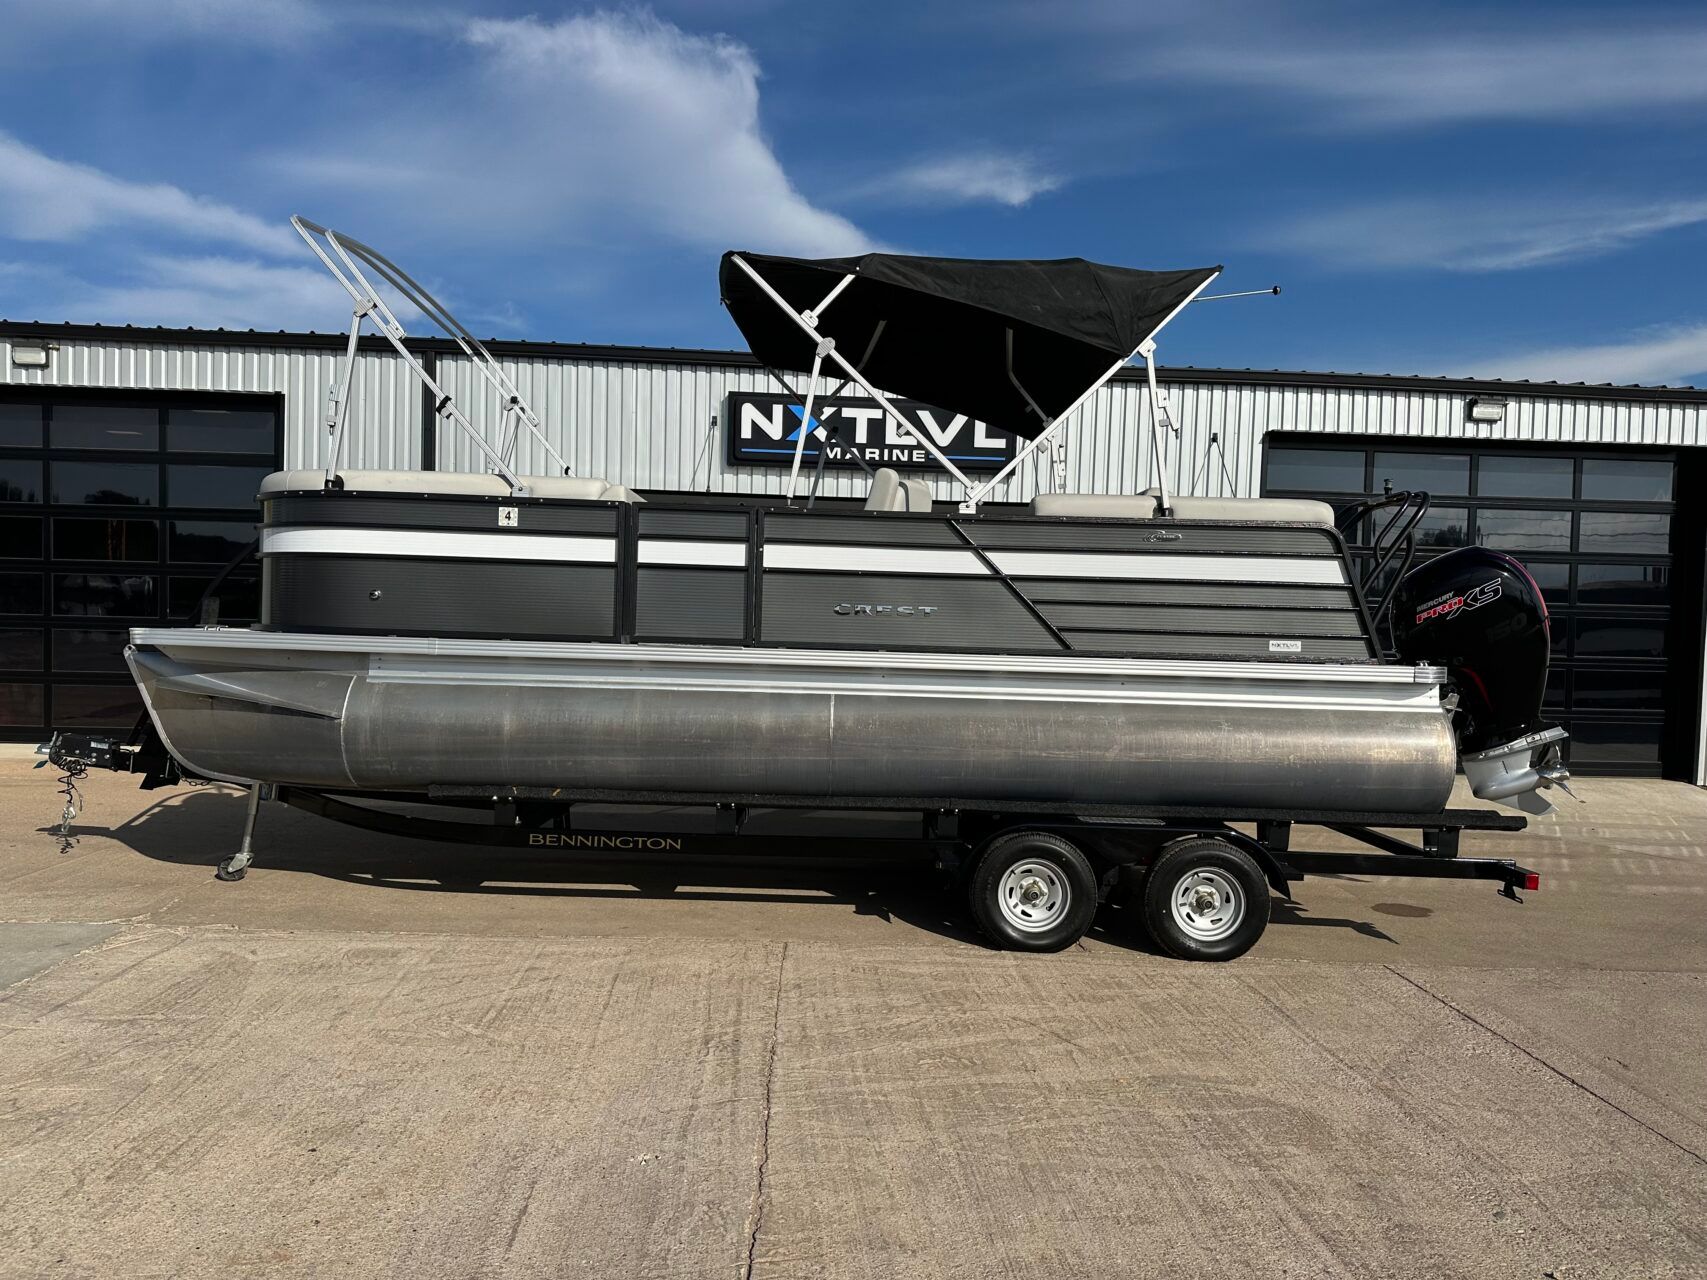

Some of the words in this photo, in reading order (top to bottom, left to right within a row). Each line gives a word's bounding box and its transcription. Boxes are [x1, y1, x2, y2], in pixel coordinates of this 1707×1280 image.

[504, 510, 512, 521] 4
[1416, 591, 1454, 613] MERCURY
[833, 603, 938, 617] CREST
[529, 833, 682, 850] BENNINGTON
